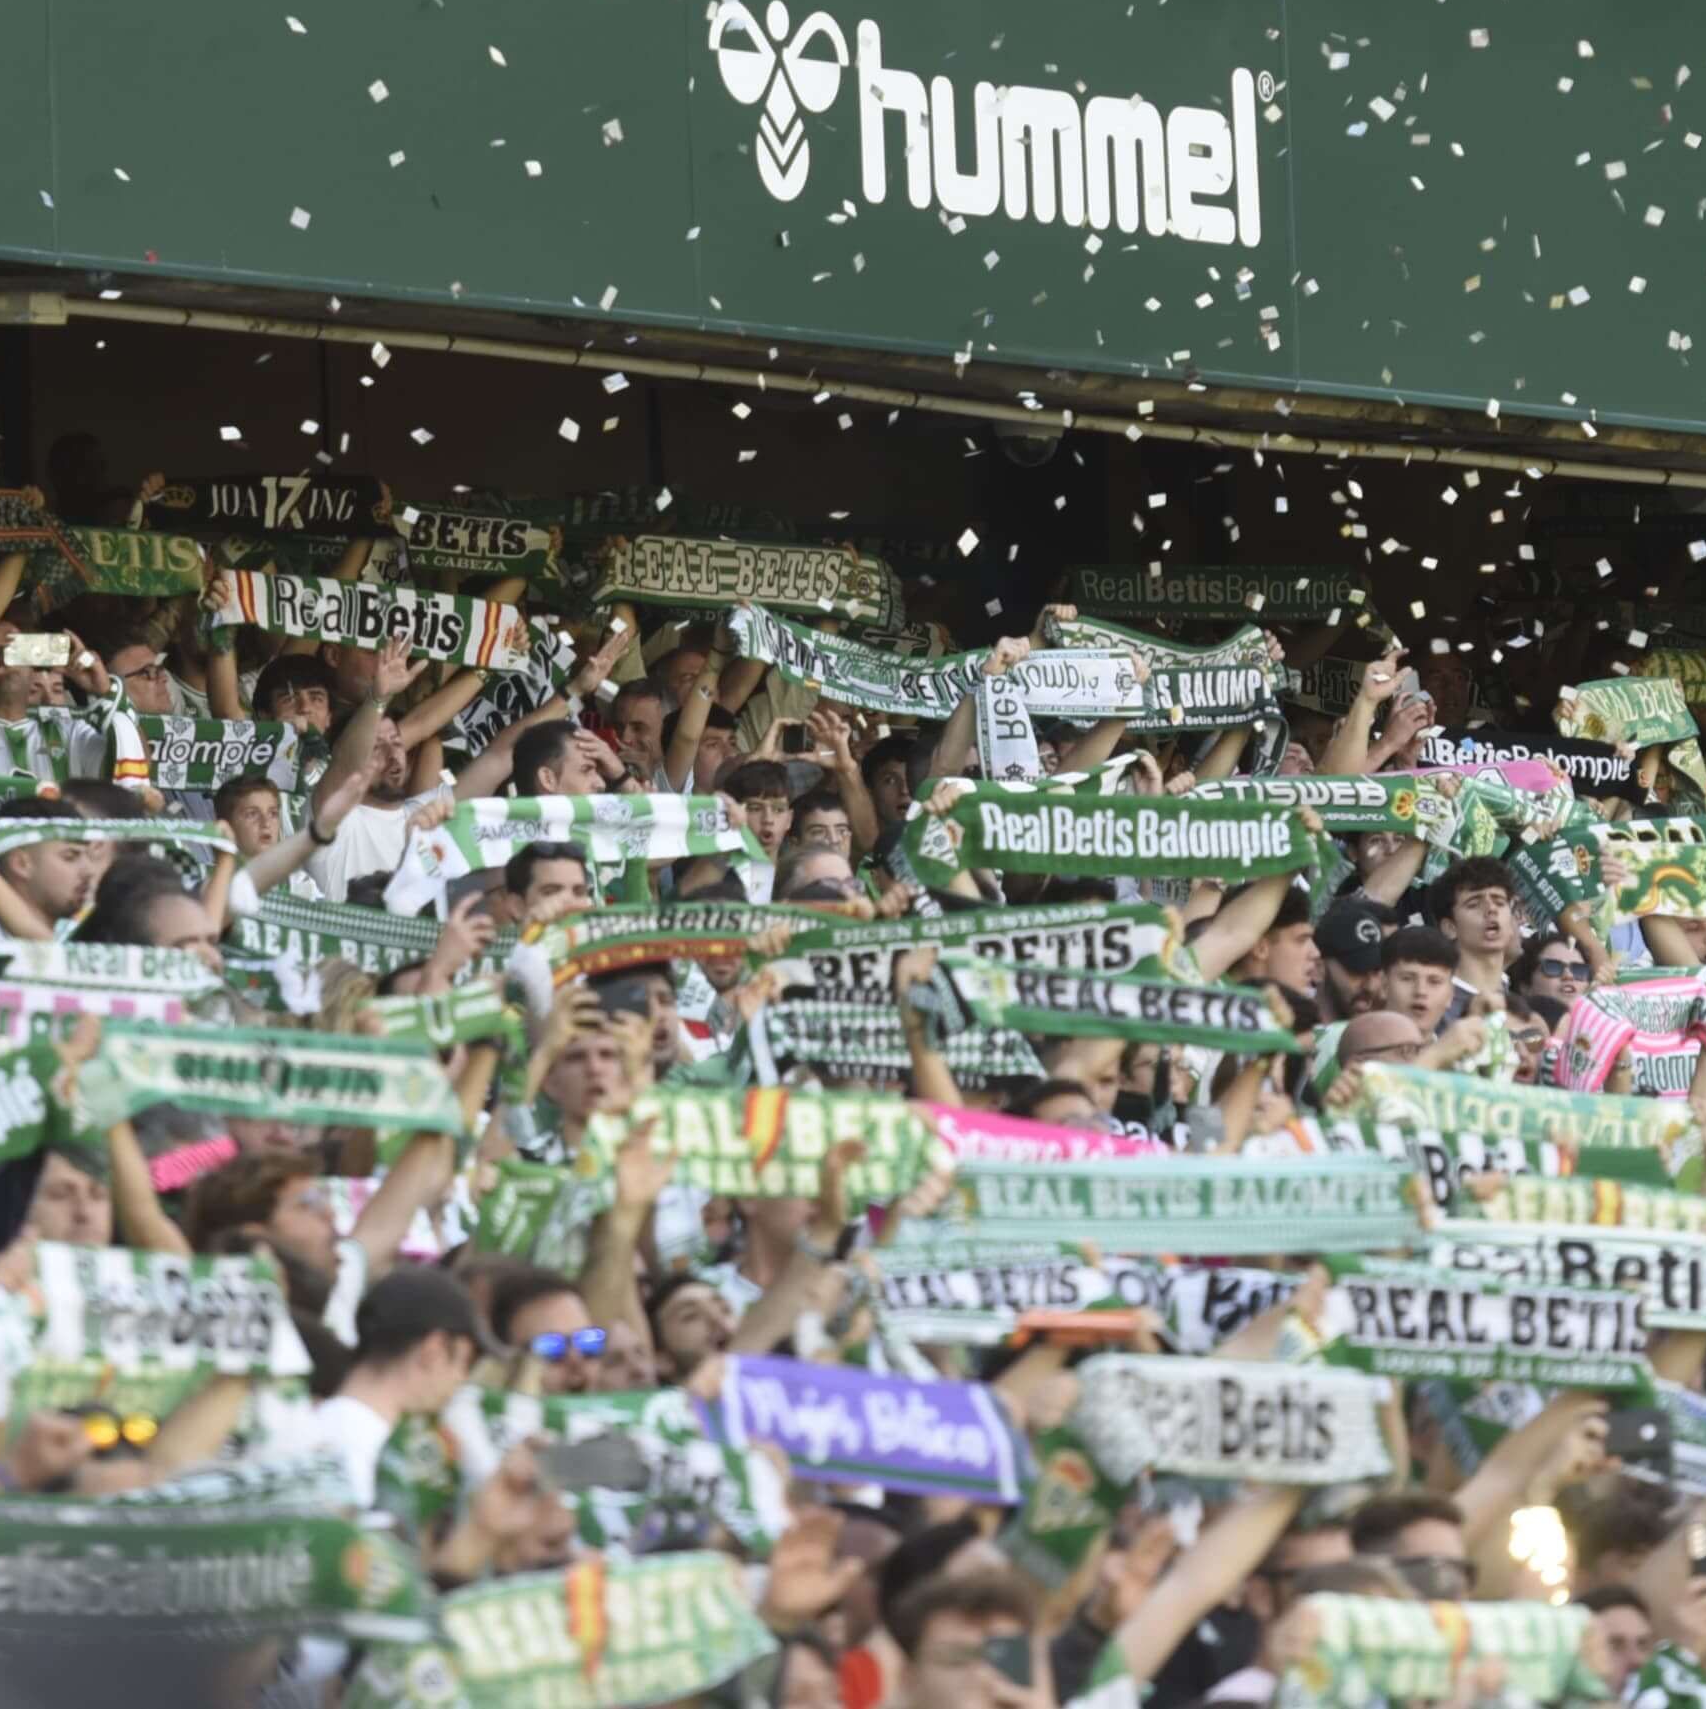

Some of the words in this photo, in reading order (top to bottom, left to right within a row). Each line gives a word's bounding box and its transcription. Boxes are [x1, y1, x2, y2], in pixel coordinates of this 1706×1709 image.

[858, 19, 1261, 248] hummel
[409, 512, 530, 556] BETIS
[735, 546, 844, 598] BETIS
[273, 573, 464, 654] RealBetis
[980, 802, 1051, 855] Real
[1062, 806, 1135, 859] Betis
[1137, 808, 1293, 869] Balompié
[920, 915, 976, 938] QUE
[1013, 969, 1125, 1015] REAL
[1138, 982, 1261, 1032] BETIS
[1351, 1277, 1494, 1345] REAL
[1510, 1290, 1647, 1355] BETIS
